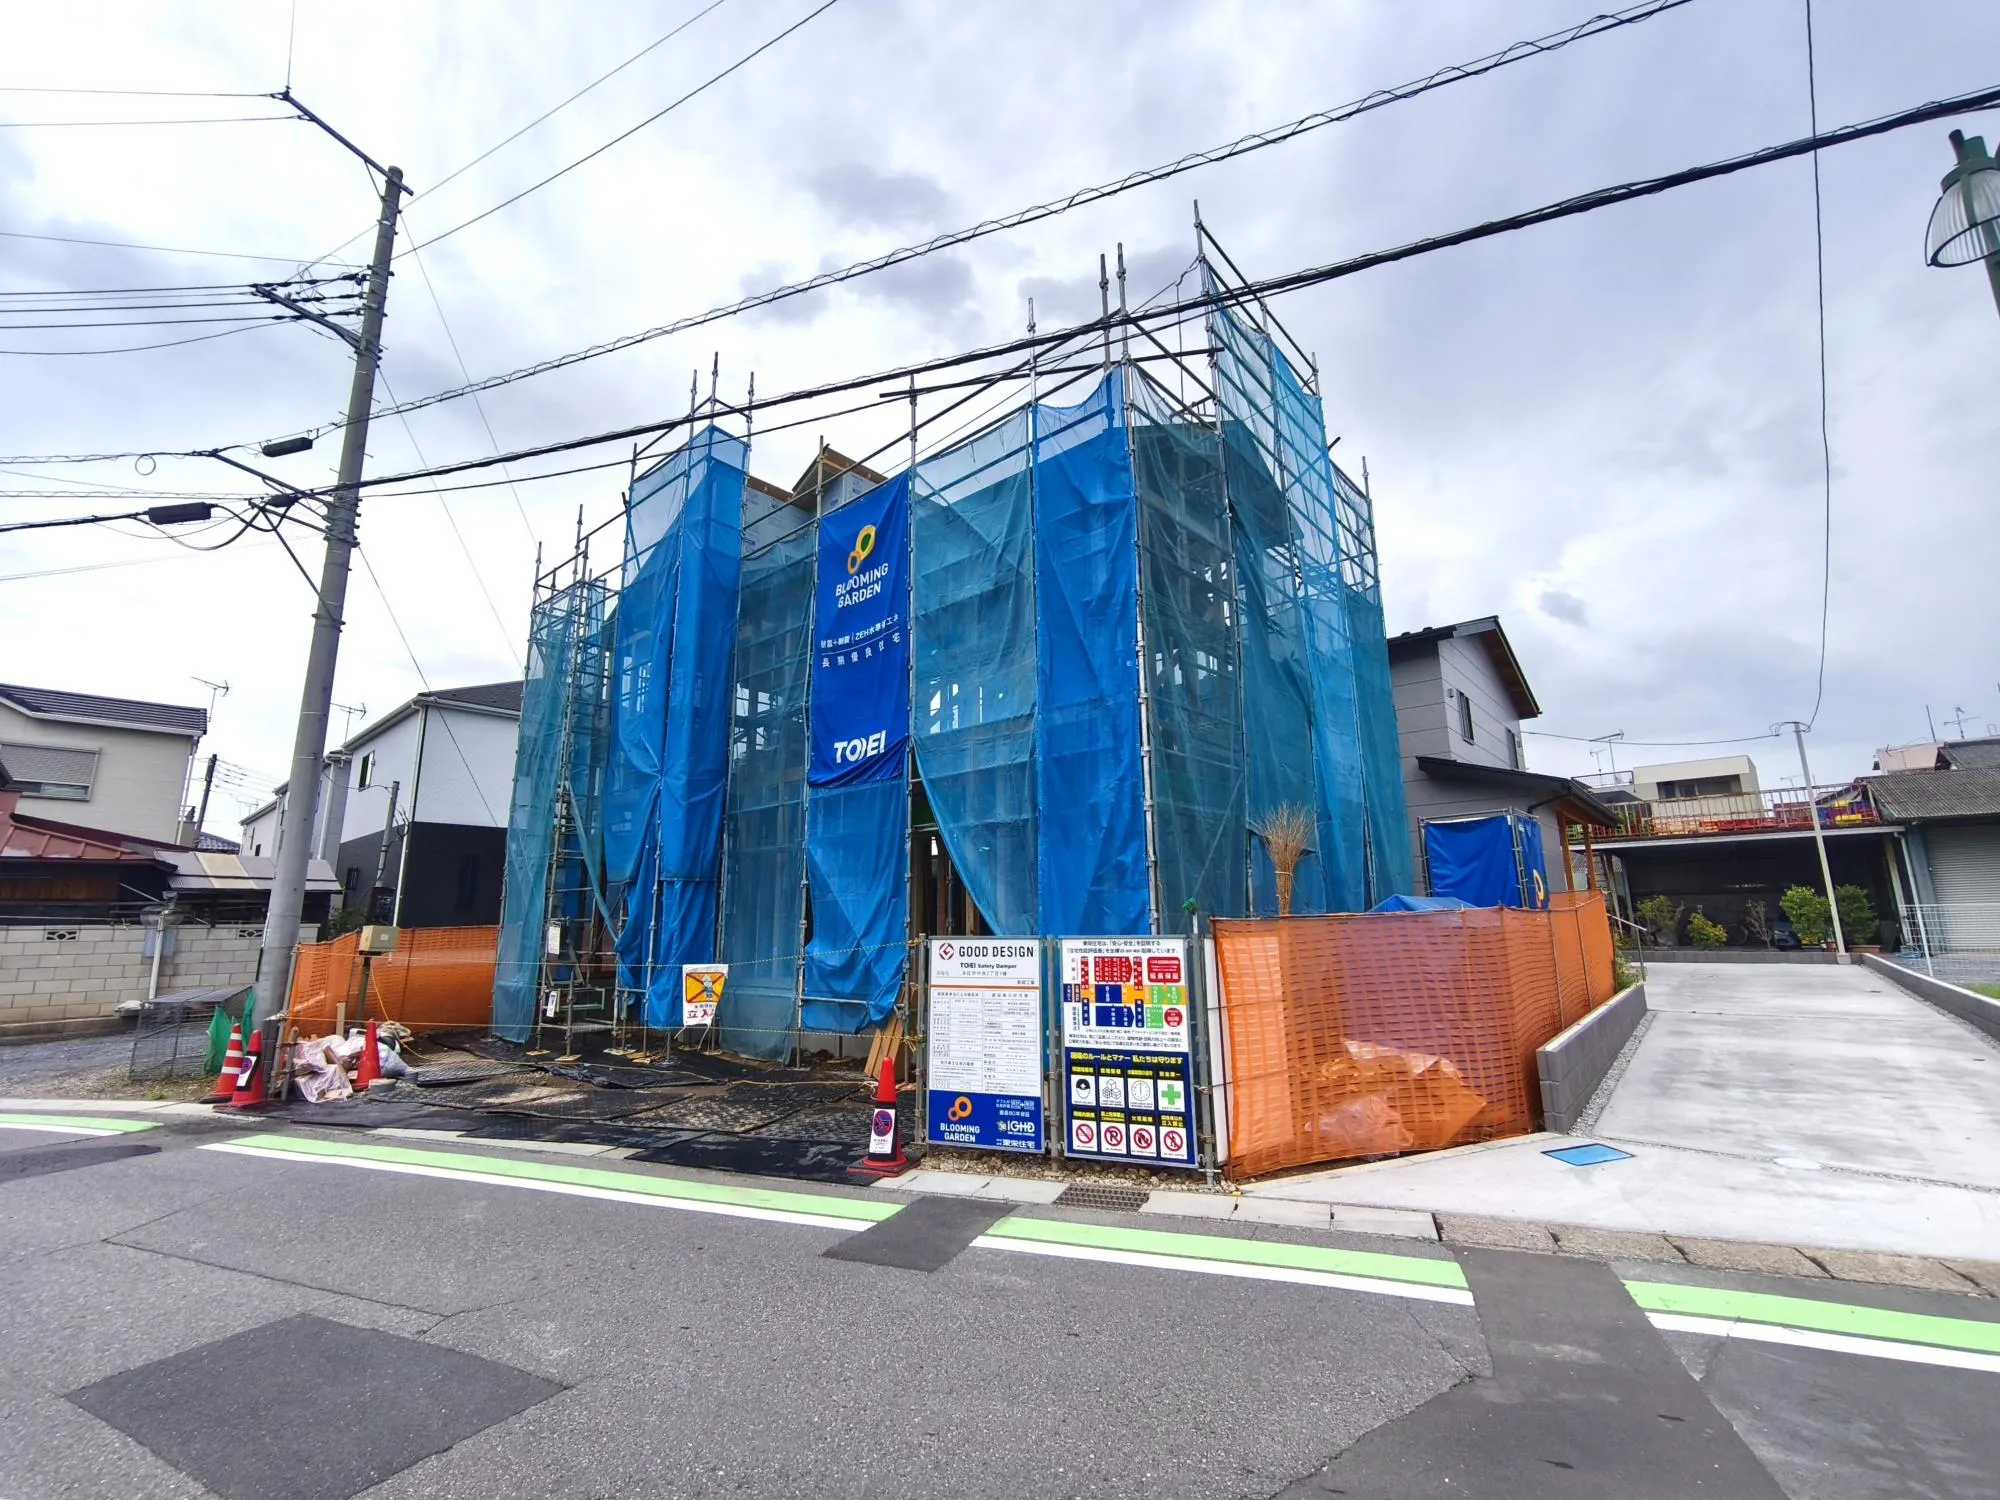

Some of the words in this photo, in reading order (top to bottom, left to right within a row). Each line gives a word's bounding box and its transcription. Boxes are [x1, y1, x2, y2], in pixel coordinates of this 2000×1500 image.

[835, 563, 888, 597] BLOOMING
[837, 581, 881, 608] GARDEN
[833, 730, 886, 763] TOEI
[958, 946, 988, 957] GOOD
[992, 946, 1034, 958] DESIGN
[940, 1122, 980, 1134] BLOOMING
[944, 1132, 976, 1143] GARDEN
